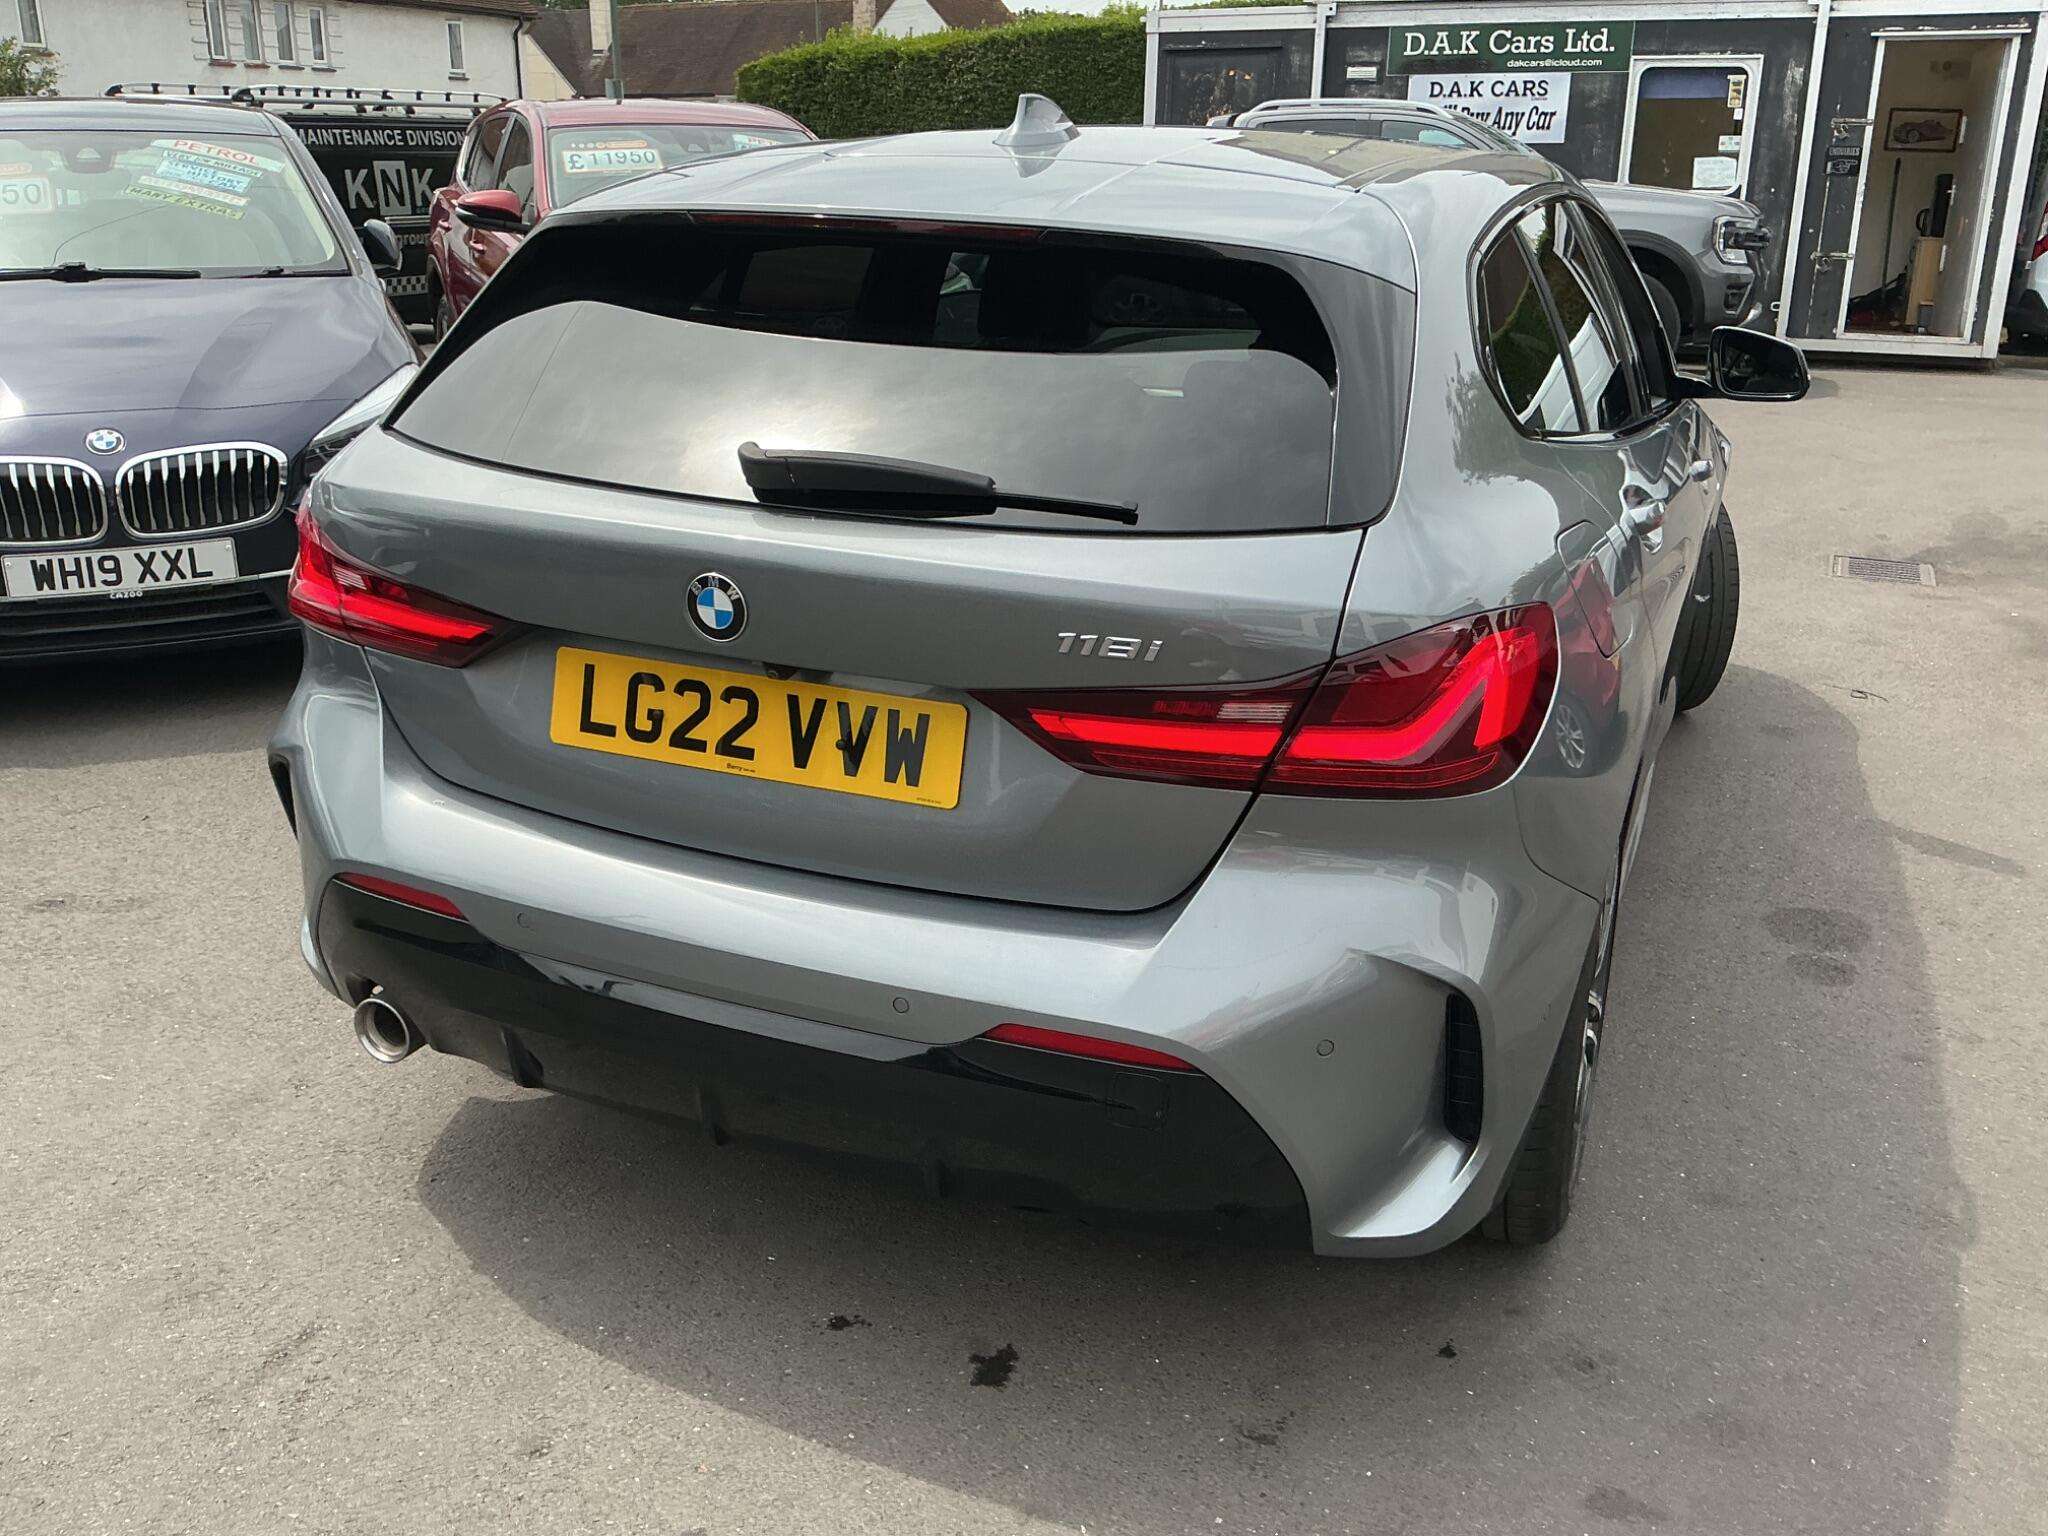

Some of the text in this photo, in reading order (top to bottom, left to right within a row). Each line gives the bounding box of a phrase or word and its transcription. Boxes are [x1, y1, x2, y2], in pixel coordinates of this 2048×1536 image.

[1403, 28, 1615, 56] D.A.K Cars Ltd.
[1507, 58, 1602, 68] dakcars@icloud.com
[1429, 80, 1549, 98] D.A.K CARS
[1492, 106, 1525, 136] Any
[1526, 106, 1557, 130] Car
[296, 129, 467, 146] MAINTENANCE DIVISION
[174, 140, 256, 165] PETROL
[569, 151, 656, 169] £11950
[130, 187, 172, 199] MANY
[175, 197, 238, 217] EXTRAS
[30, 548, 213, 590] WH19 XXL
[110, 590, 143, 599] CAZOO
[1058, 632, 1163, 661] 118i
[580, 663, 930, 787] LG22 VVW
